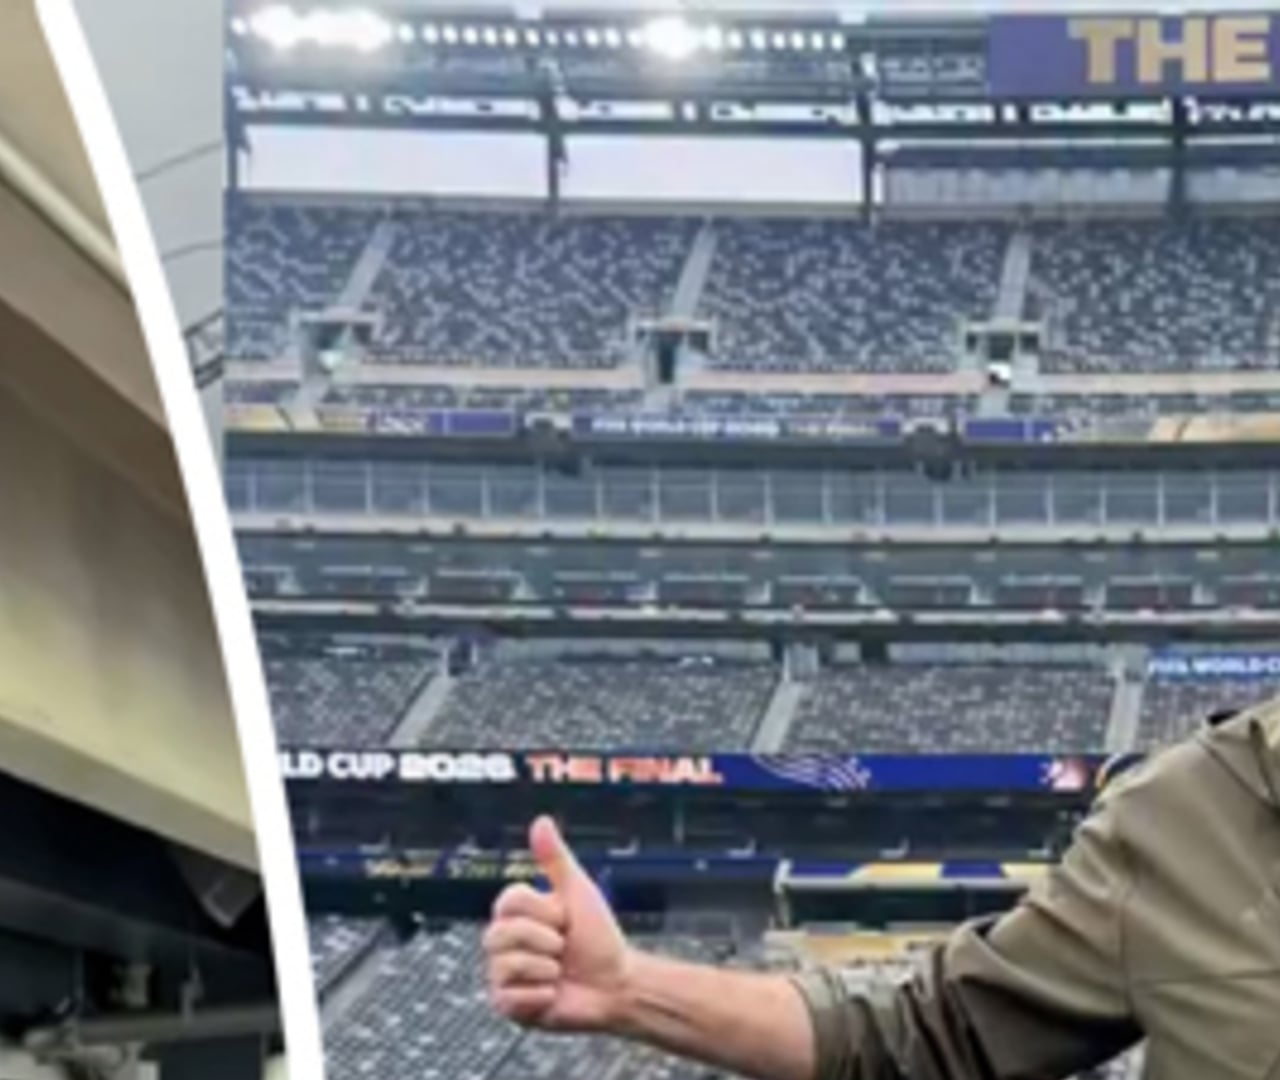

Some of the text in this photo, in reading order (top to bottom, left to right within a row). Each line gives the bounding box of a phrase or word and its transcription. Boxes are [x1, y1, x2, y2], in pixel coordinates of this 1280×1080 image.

[1068, 17, 1271, 83] THE
[326, 752, 396, 779] CUP
[525, 753, 602, 783] THE
[609, 754, 723, 783] FINAL
